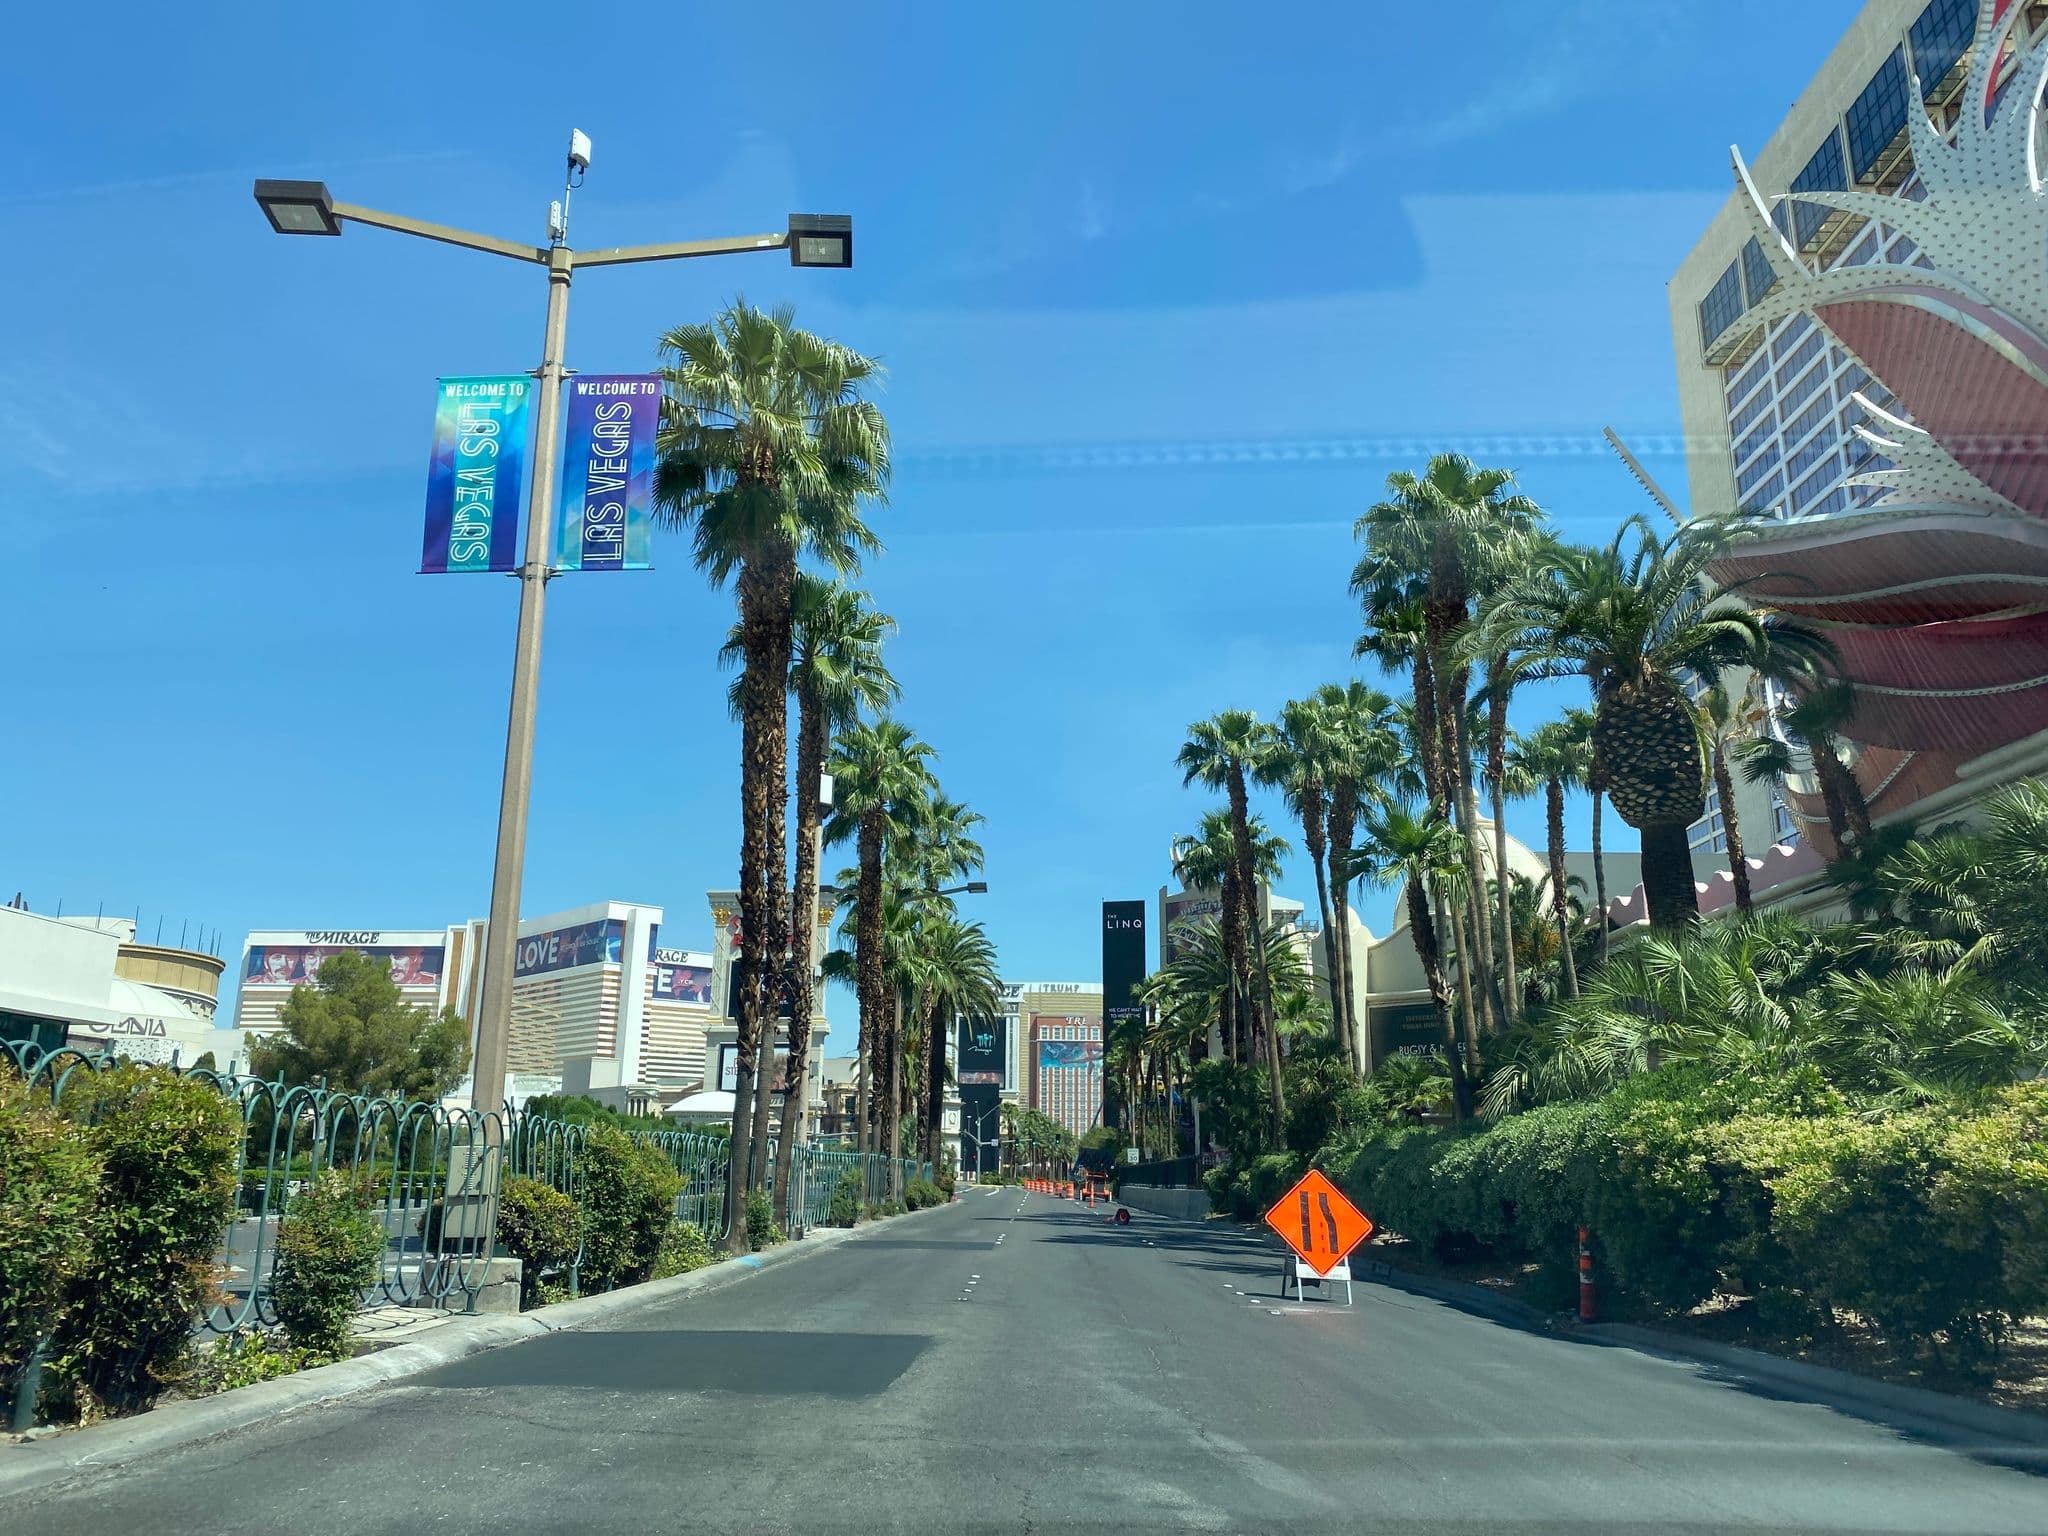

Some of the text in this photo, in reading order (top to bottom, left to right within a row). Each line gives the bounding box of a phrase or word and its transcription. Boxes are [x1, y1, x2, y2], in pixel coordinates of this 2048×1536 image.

[445, 383, 524, 397] WELCOME TO
[577, 382, 656, 396] WELCOME TO
[450, 402, 502, 562] LAS VEGAS
[583, 401, 632, 561] LAS VEGAS
[1107, 919, 1142, 929] LINQ
[310, 932, 380, 944] MIRAGE
[516, 936, 560, 970] LOVE
[1043, 983, 1080, 992] TRUMP
[1399, 1044, 1428, 1056] BUGSY
[1429, 1043, 1437, 1054] &
